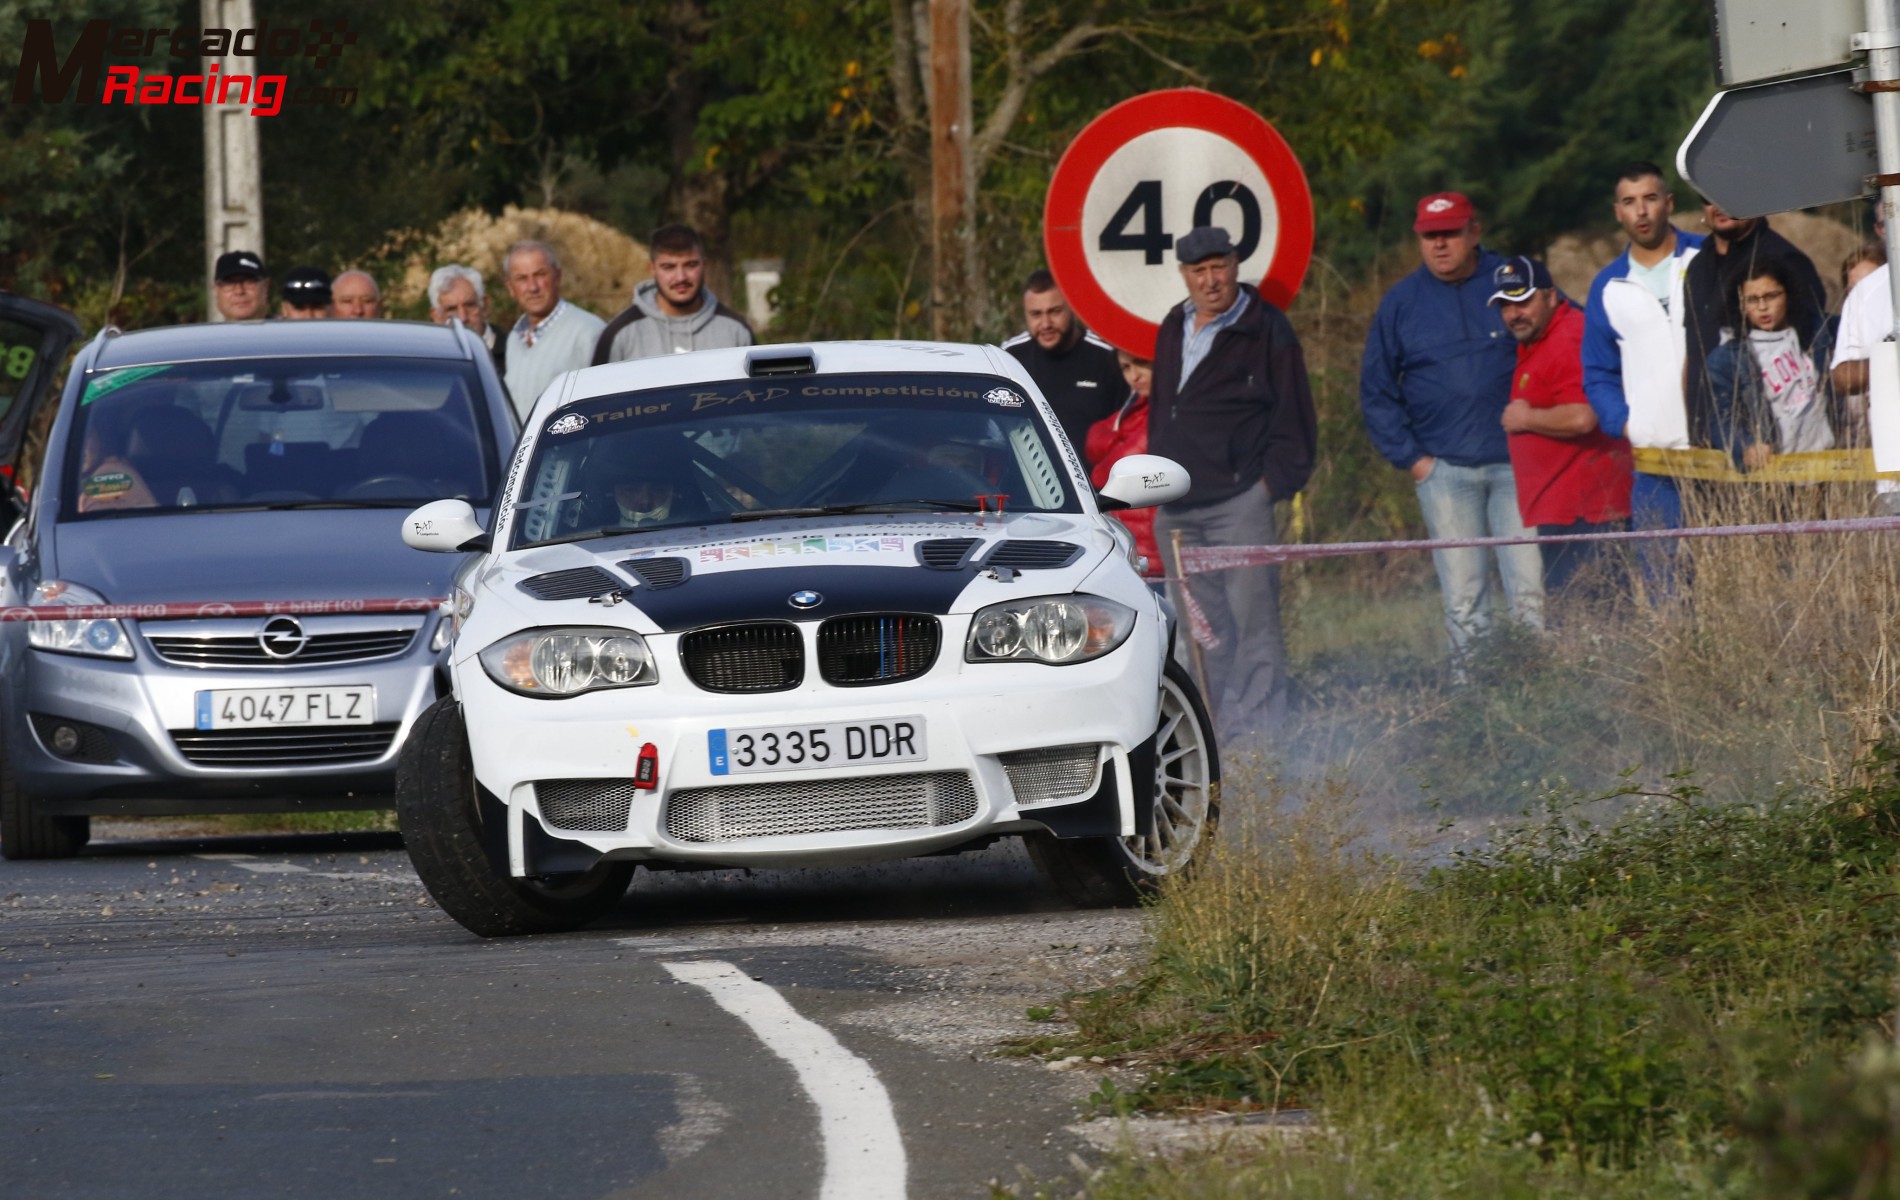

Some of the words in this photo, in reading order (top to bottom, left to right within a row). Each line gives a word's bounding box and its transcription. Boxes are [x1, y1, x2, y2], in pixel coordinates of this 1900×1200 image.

[1098, 180, 1262, 266] 40
[591, 402, 672, 424] Taller
[688, 387, 790, 413] BAD
[801, 386, 979, 400] Competición
[1142, 471, 1166, 489] BAD
[414, 520, 434, 536] BAD
[663, 537, 782, 553] Concello
[221, 694, 295, 722] 4047
[307, 693, 362, 720] FLZ
[736, 728, 831, 767] 3335
[845, 722, 917, 760] DDR
[715, 756, 724, 766] E
